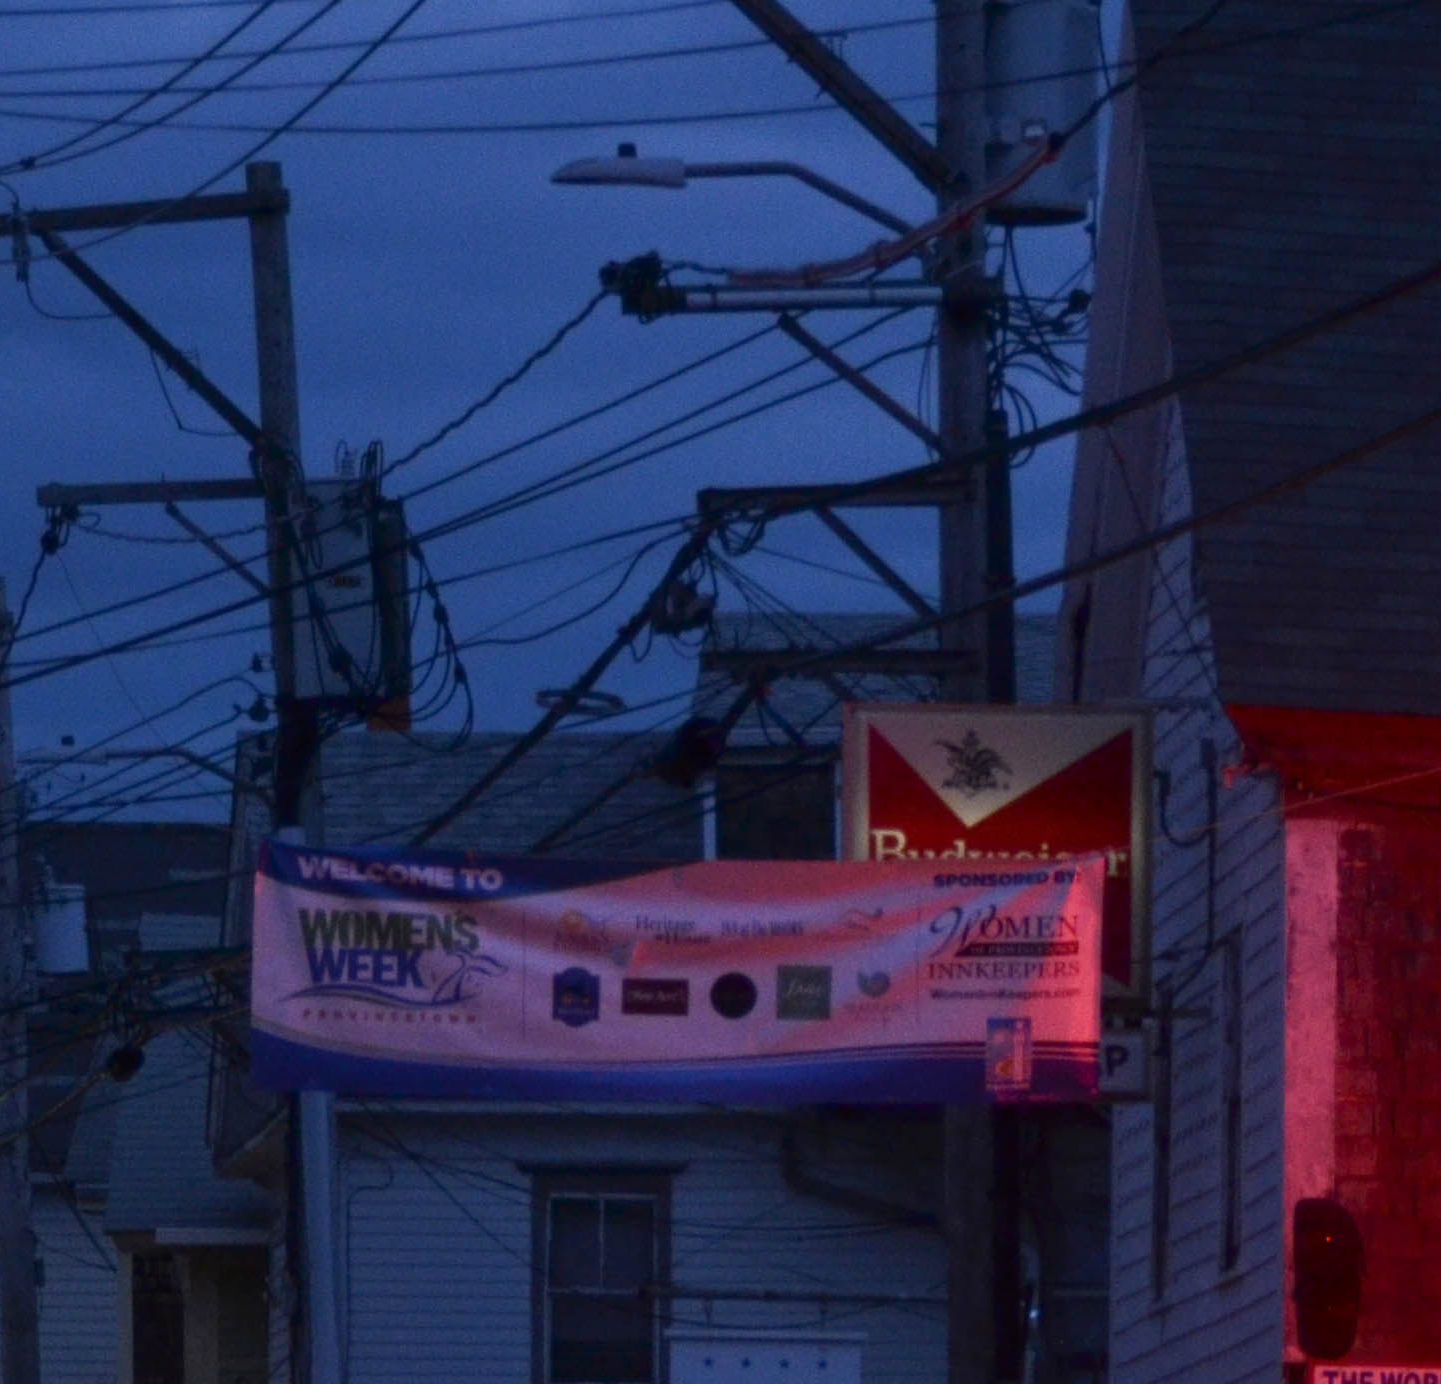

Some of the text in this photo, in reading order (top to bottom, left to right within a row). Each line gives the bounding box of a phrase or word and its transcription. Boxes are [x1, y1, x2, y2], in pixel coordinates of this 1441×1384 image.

[297, 855, 504, 891] WELCOME TO
[934, 872, 1049, 888] SPONSORED
[298, 908, 480, 951] WOMEN'S
[929, 904, 1078, 957] WOMEN
[306, 949, 425, 988] WEEK
[927, 961, 1080, 980] INNKEEPERS
[302, 1008, 478, 1025] PROVINCETOWN
